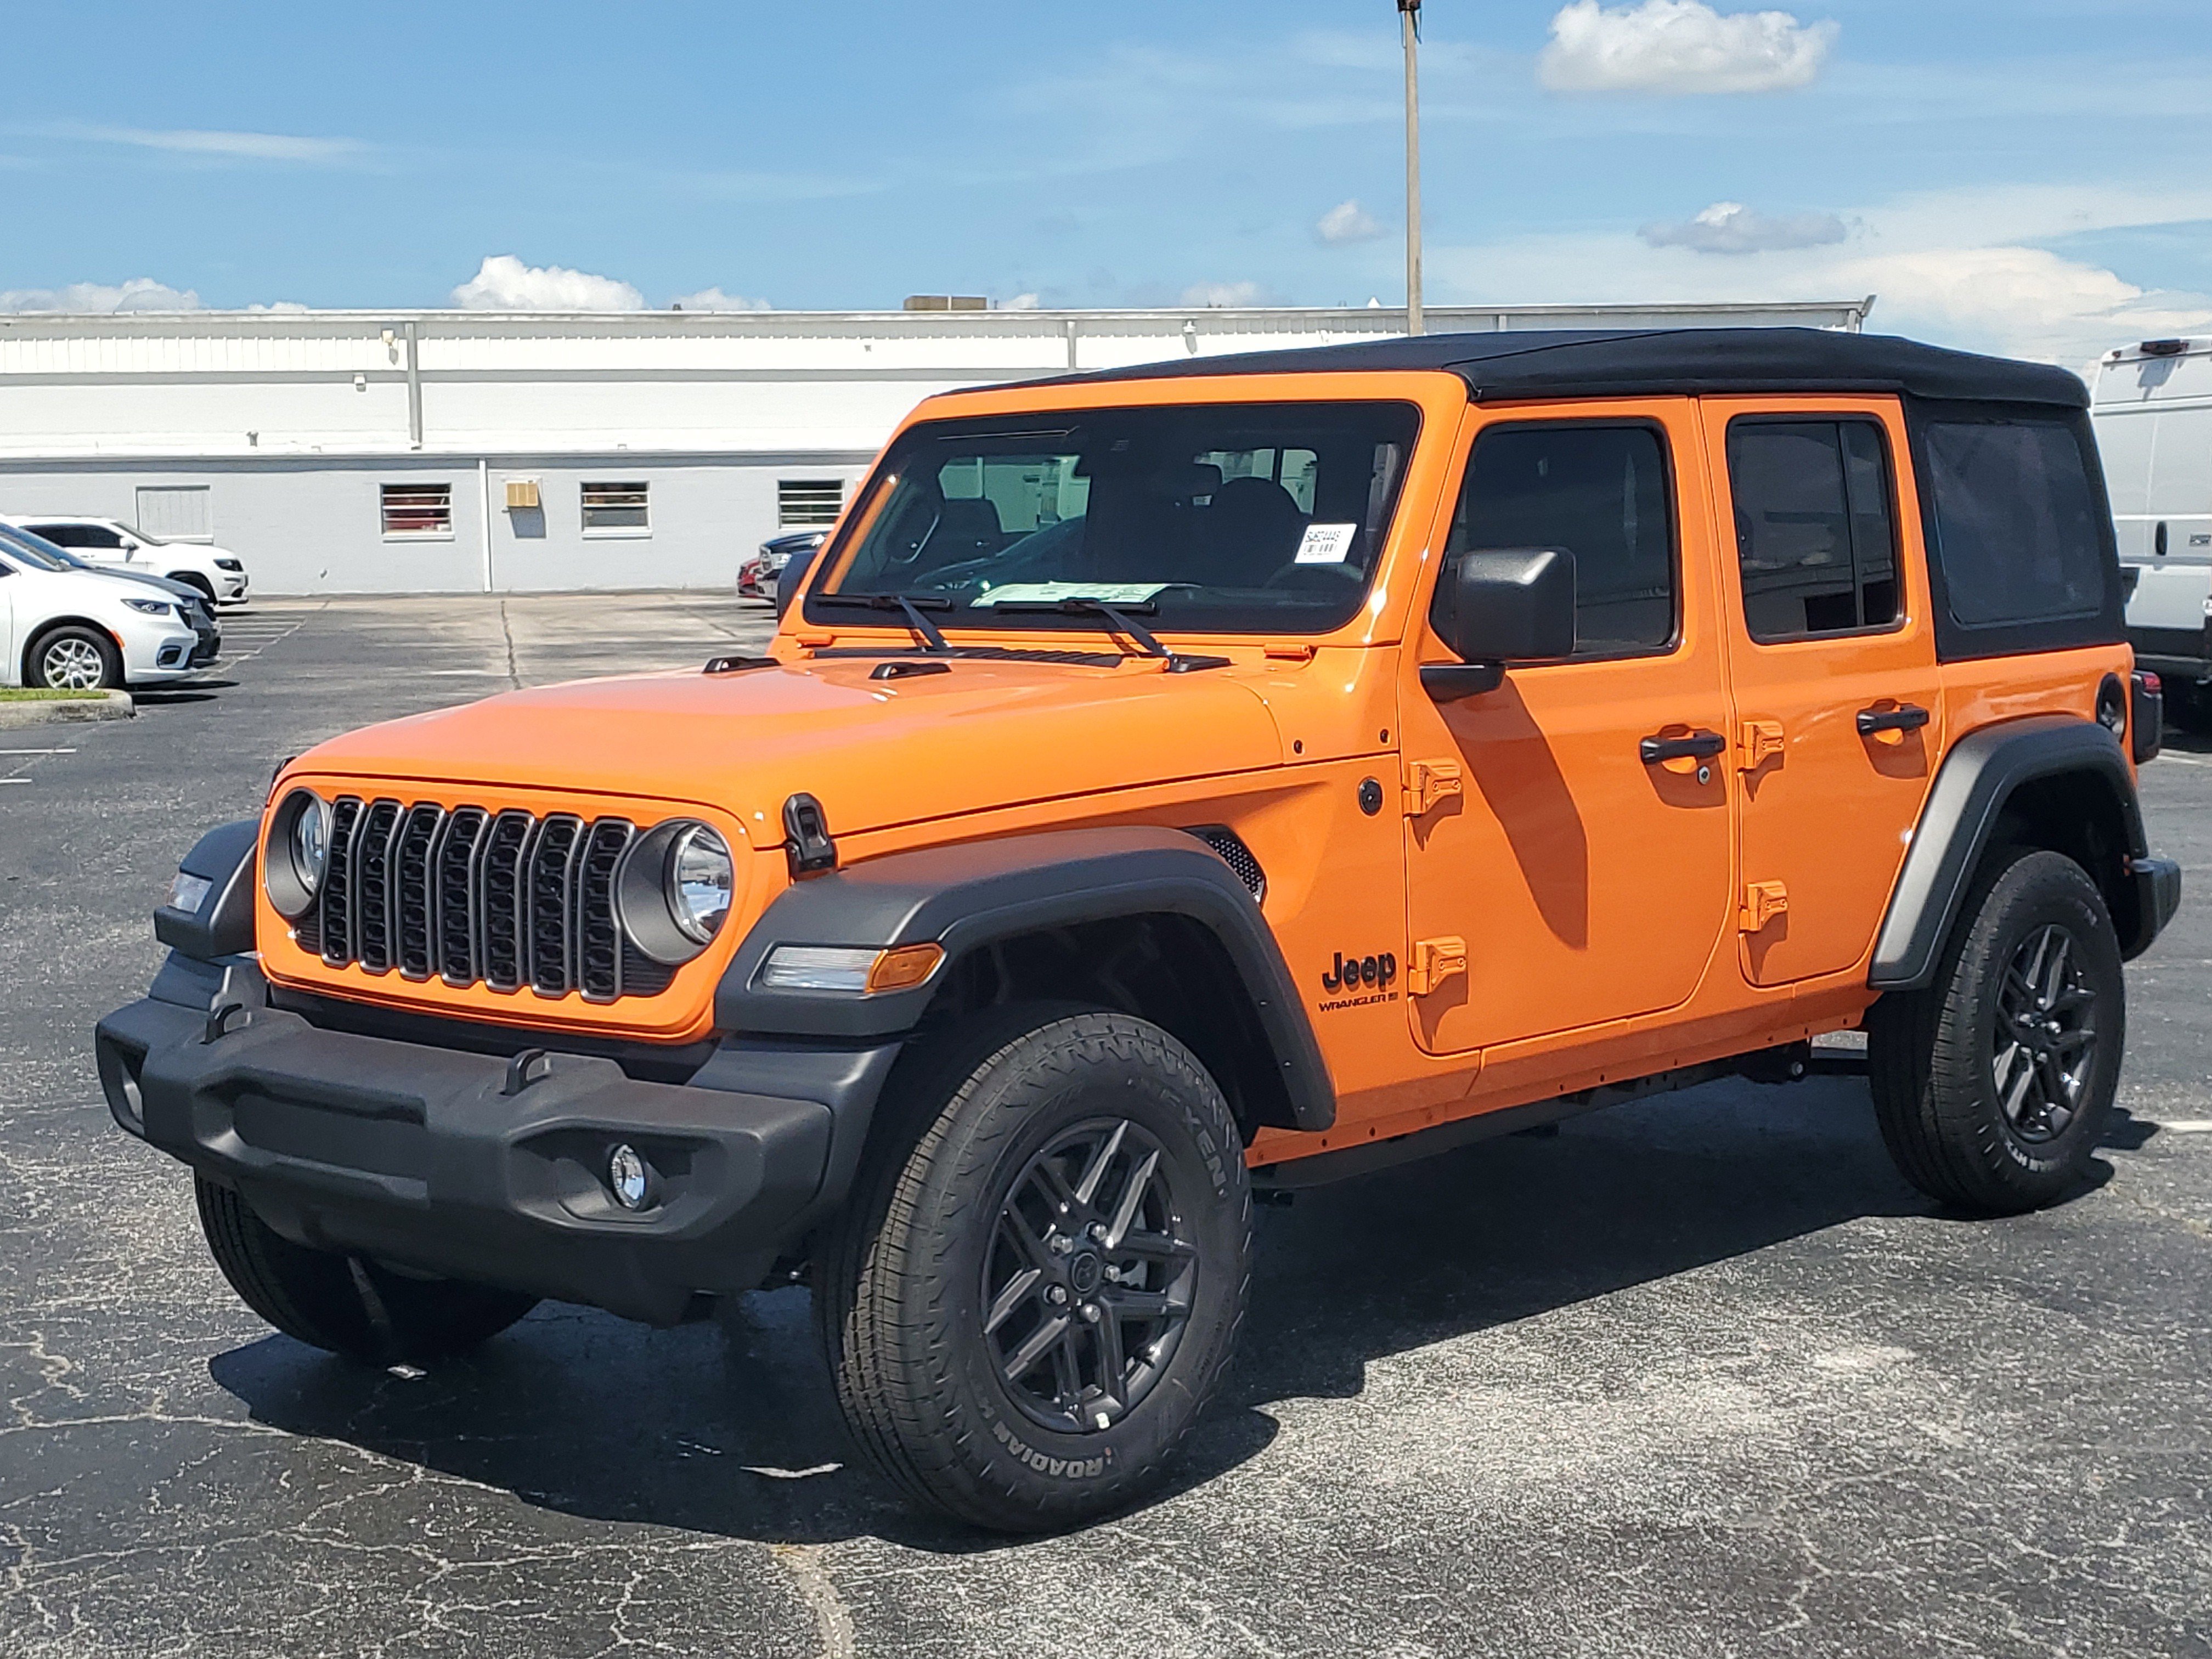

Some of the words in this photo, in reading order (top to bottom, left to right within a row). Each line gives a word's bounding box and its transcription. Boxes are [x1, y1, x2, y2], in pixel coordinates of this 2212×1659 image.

[1322, 952, 1397, 989] Jeep
[1319, 994, 1386, 1012] WRANGLER
[992, 1420, 1103, 1479] ROADIAN
